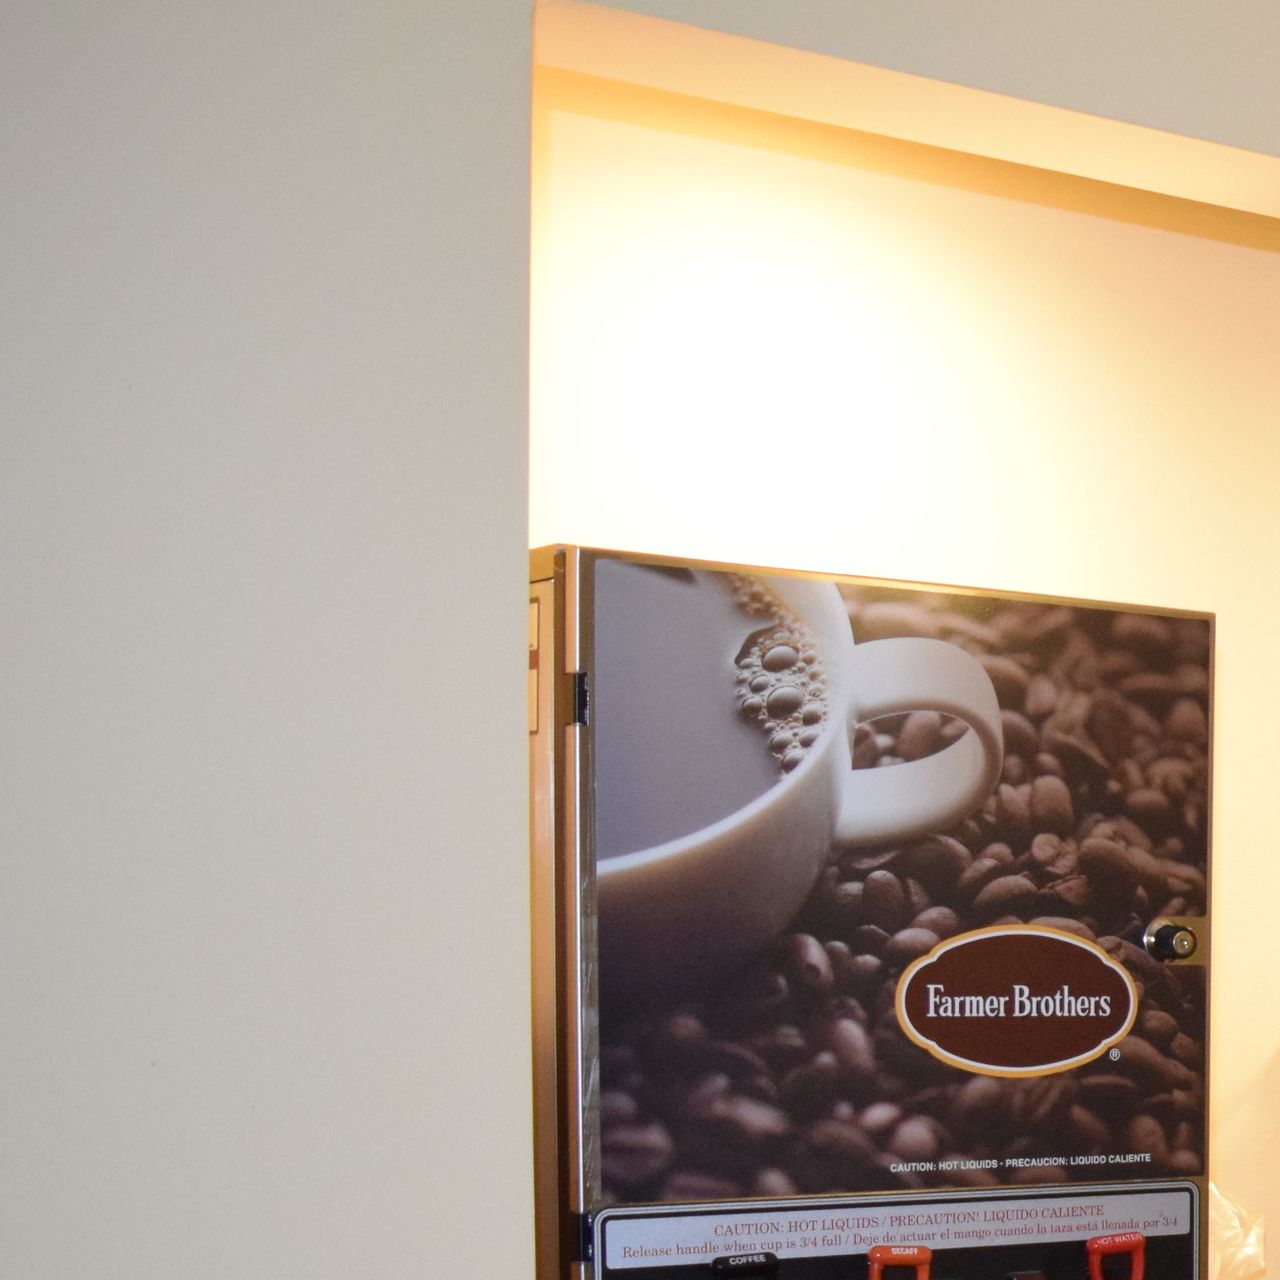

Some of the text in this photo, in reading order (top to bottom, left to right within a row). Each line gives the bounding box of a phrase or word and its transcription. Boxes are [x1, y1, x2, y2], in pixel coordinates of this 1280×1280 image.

[926, 984, 1111, 1017] Farmer Brothers
[890, 1153, 1152, 1173] CAUTION: HOT LIQUIDS PRECAUCION: LIQUIDO CALIENTE
[714, 1223, 785, 1237] CAUTION:
[788, 1220, 819, 1233] HOT
[822, 1217, 879, 1232] LIQUIDS
[983, 1207, 1038, 1223] LIQUIDO
[1041, 1204, 1105, 1219] CALIENTE
[623, 1244, 672, 1258] Release
[676, 1240, 720, 1255] handle
[723, 1239, 757, 1252] when
[760, 1240, 783, 1254] cup
[786, 1238, 796, 1249] is
[800, 1236, 818, 1248] 3/4
[821, 1234, 842, 1247] full
[853, 1232, 880, 1248] Deje
[882, 1231, 897, 1243] de
[900, 1230, 936, 1243] actuar
[939, 1228, 951, 1240] el
[953, 1226, 992, 1241] mango
[994, 1223, 1034, 1237] cuando
[1036, 1222, 1047, 1235] la
[1050, 1222, 1073, 1234] taza
[1101, 1216, 1140, 1230] llenada
[1143, 1217, 1161, 1230] por
[1162, 1215, 1178, 1227] 3/4
[1096, 1233, 1143, 1246] HOT WATER
[729, 1254, 767, 1265] COFFEE
[890, 1247, 919, 1256] DECAFF
